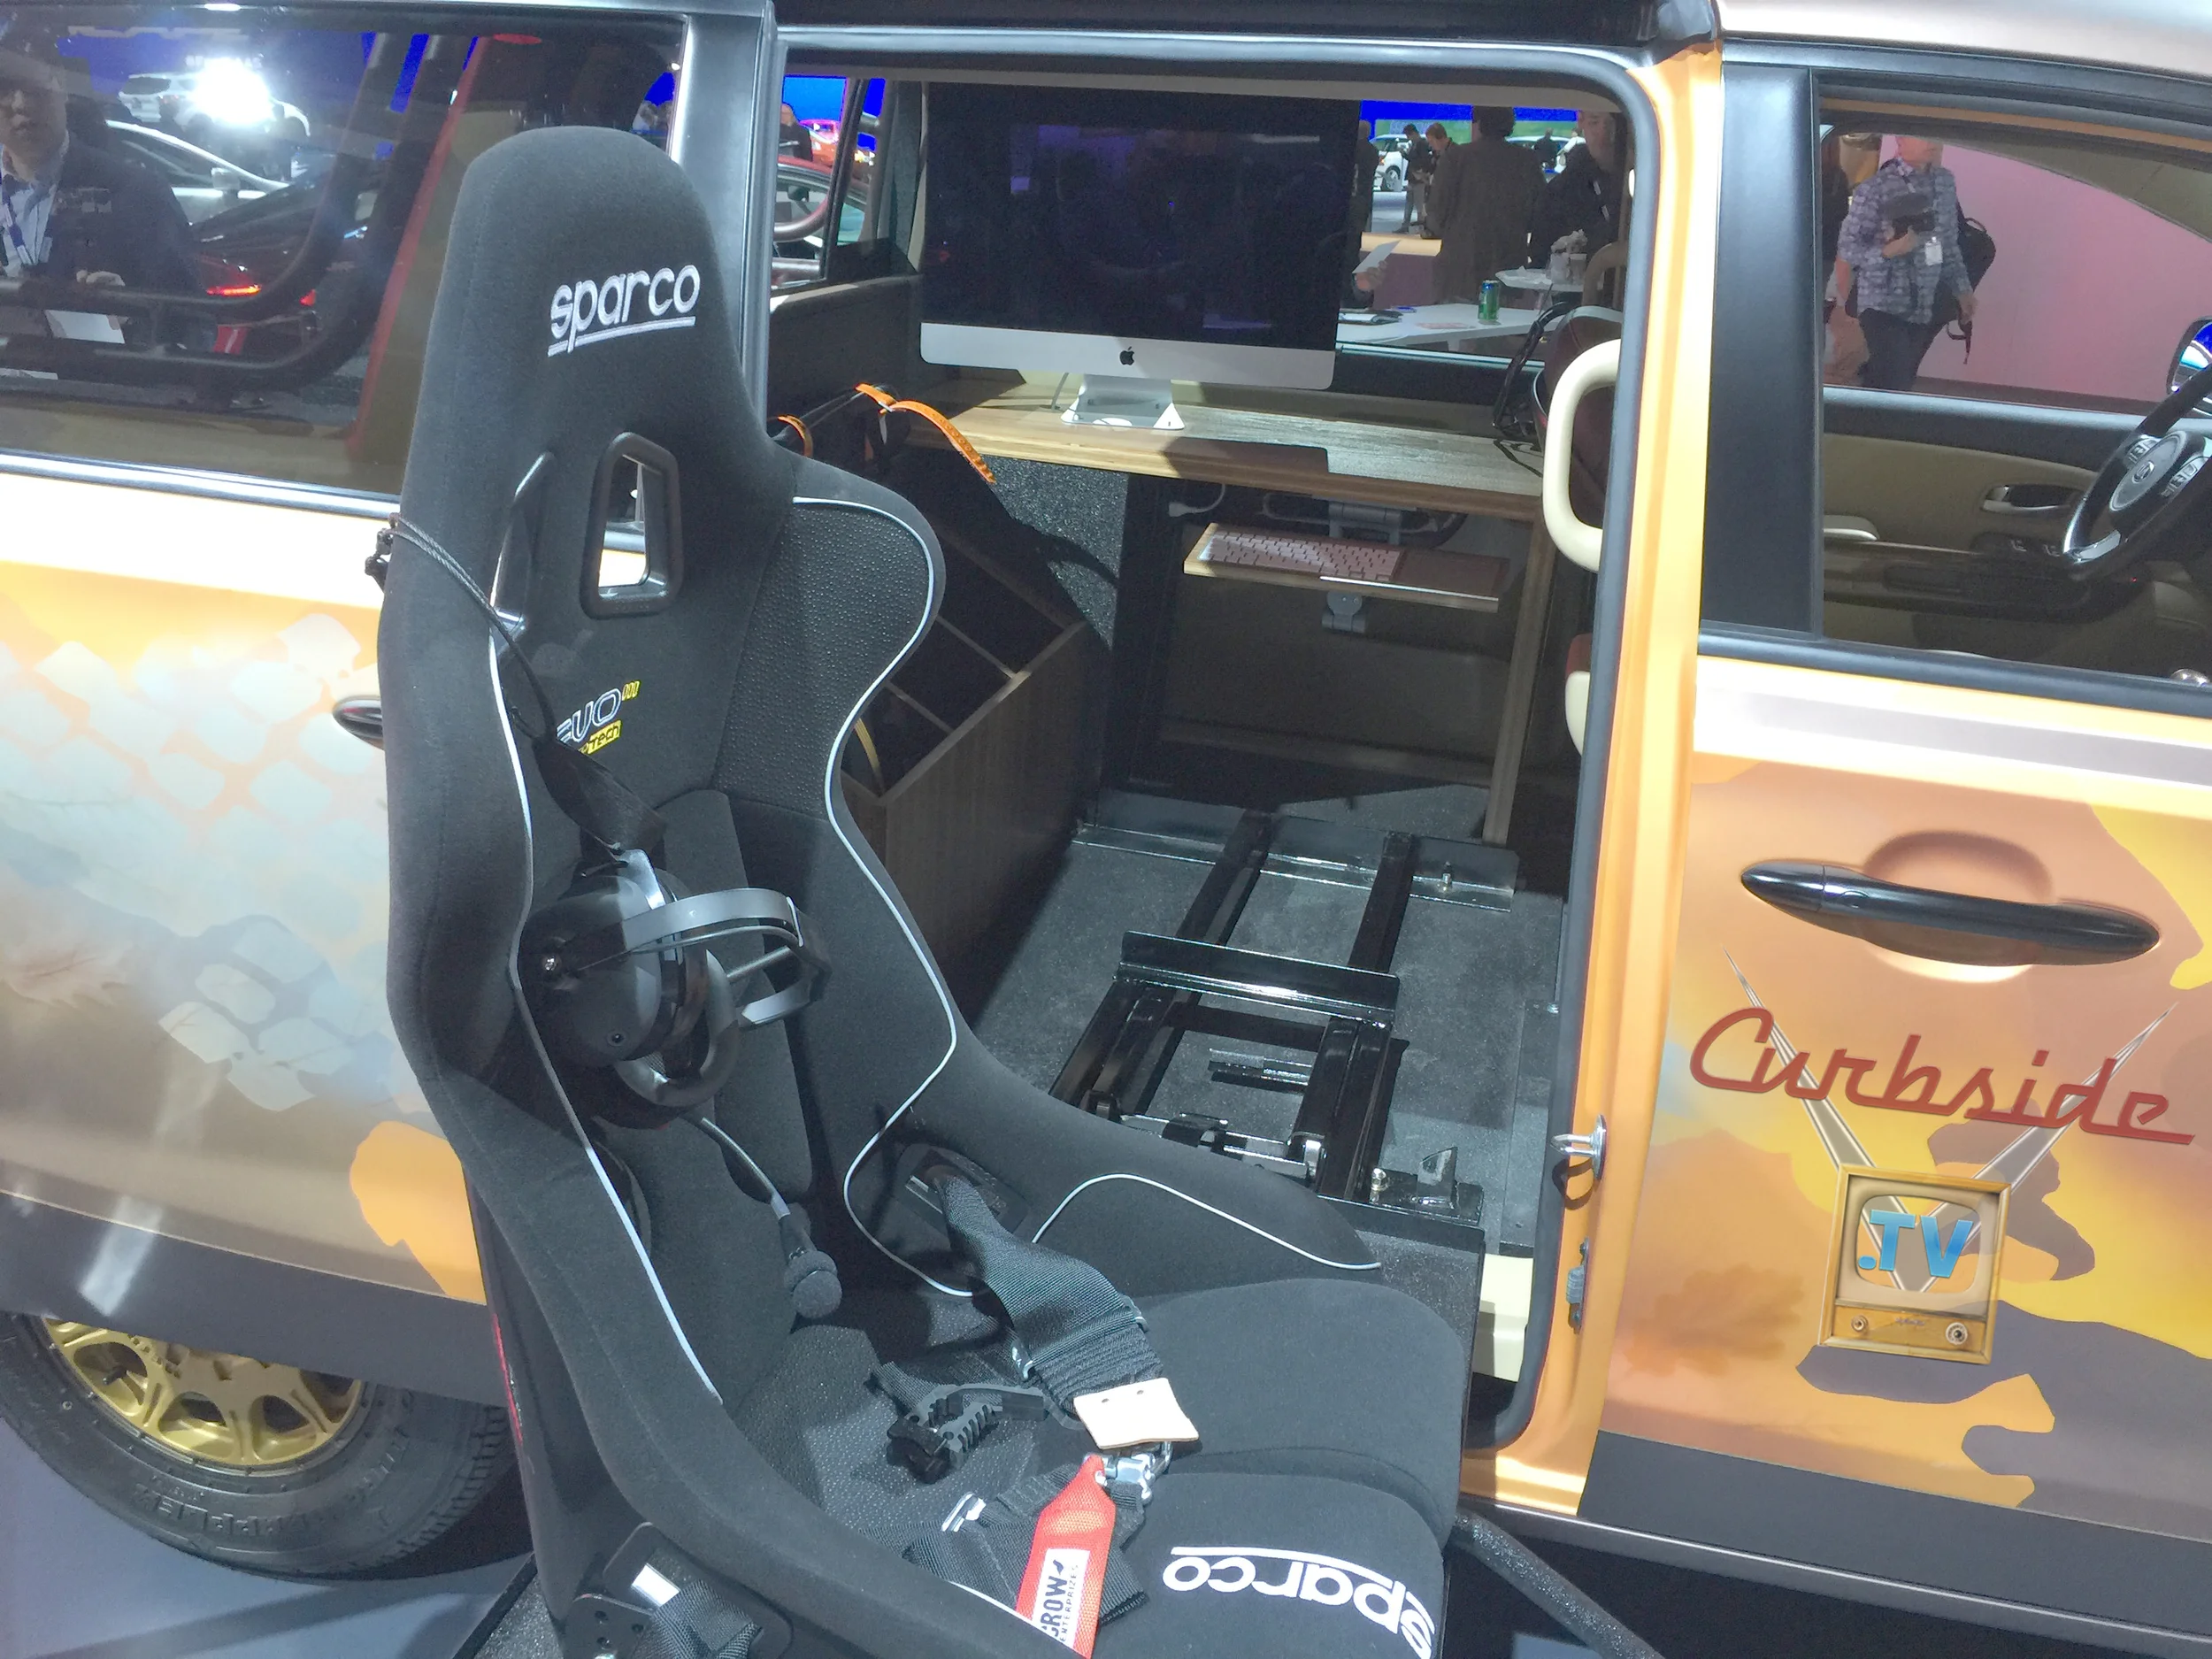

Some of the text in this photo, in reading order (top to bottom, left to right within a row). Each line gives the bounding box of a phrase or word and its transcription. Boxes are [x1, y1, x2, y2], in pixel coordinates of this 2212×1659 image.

[549, 265, 701, 355] sparco
[1690, 1007, 2196, 1145] Curbside
[1162, 1555, 1433, 1659] sparco
